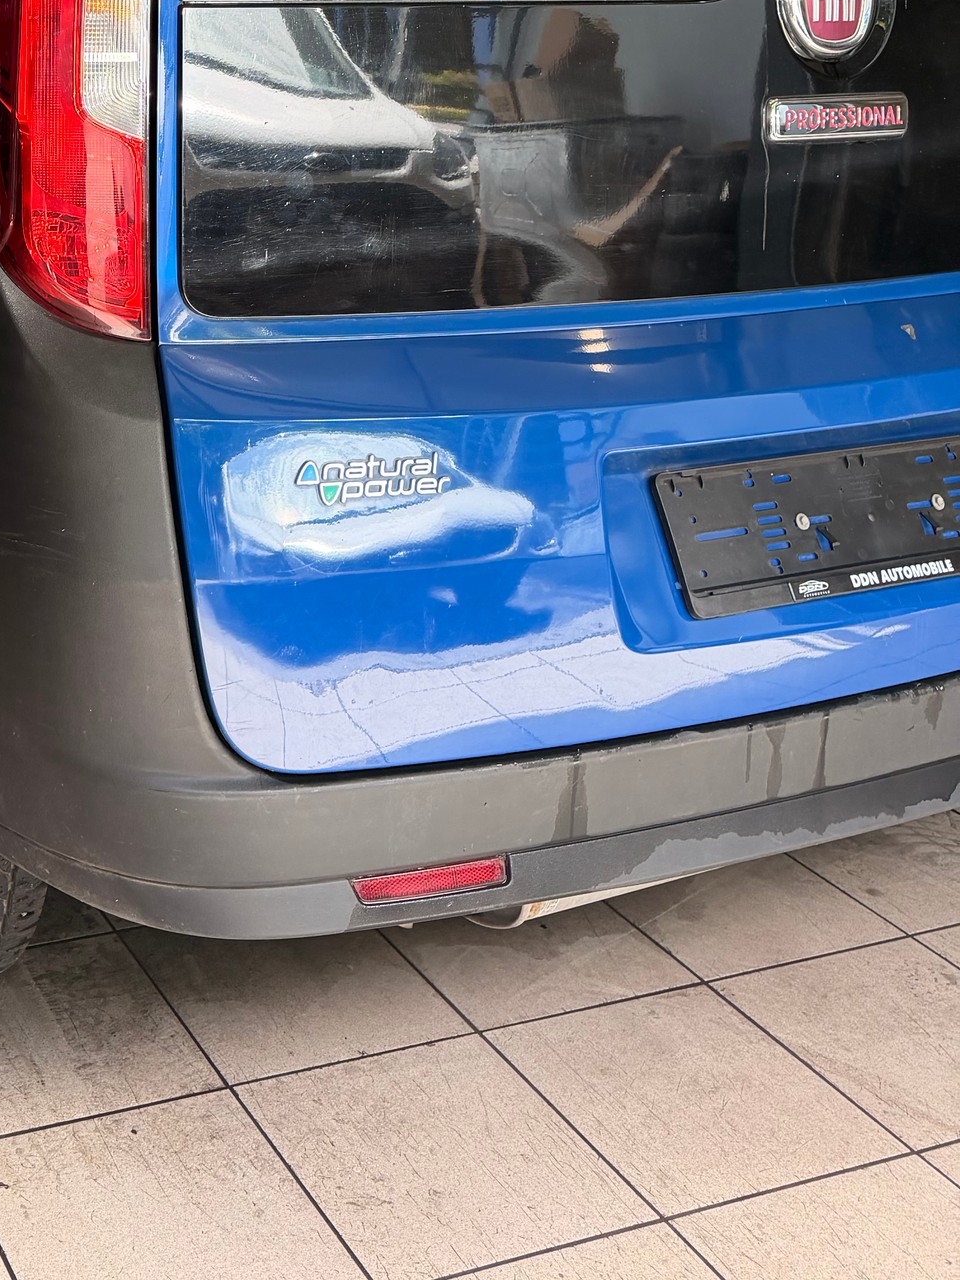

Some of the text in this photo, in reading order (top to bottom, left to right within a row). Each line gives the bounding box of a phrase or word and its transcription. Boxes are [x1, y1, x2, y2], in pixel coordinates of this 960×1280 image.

[785, 105, 904, 130] PROFESSIONAL
[321, 452, 439, 480] natural
[341, 476, 451, 504] power
[850, 558, 955, 588] DDN AUTOMOBILE
